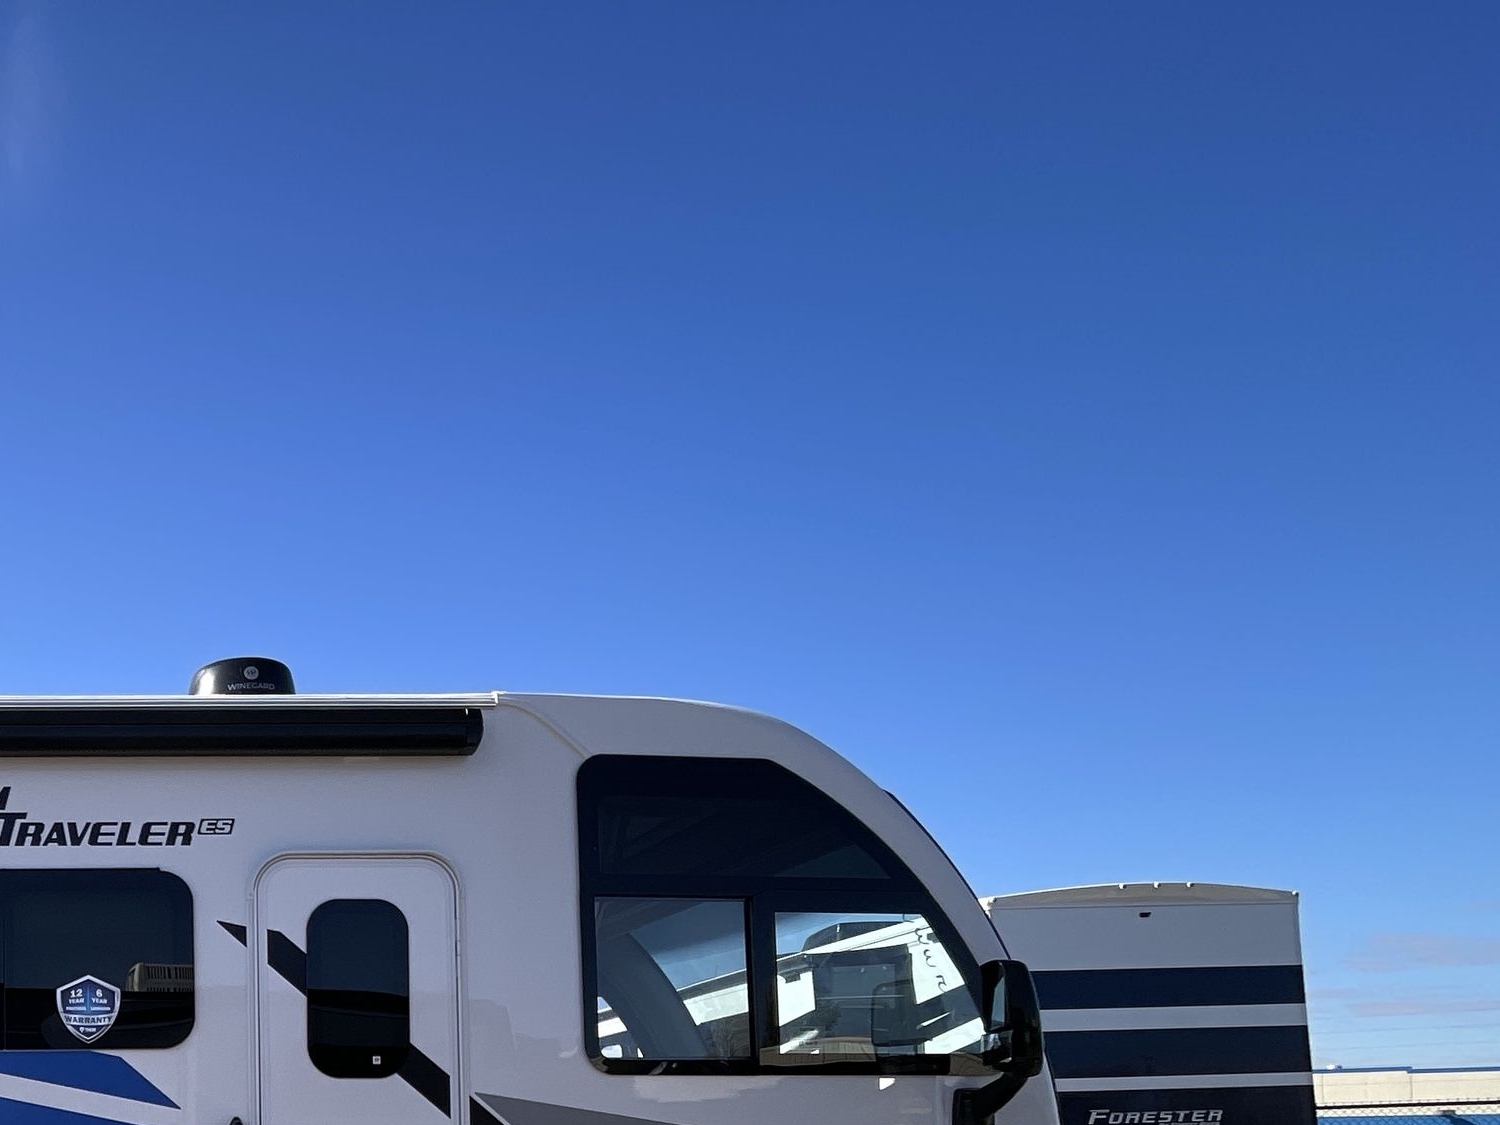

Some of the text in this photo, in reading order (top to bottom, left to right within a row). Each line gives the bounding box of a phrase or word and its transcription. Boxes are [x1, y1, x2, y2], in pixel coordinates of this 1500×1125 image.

[199, 819, 234, 835] ES
[70, 989, 83, 998] 12
[64, 1016, 112, 1024] WARRANTY
[1088, 1109, 1223, 1125] FORESTER
